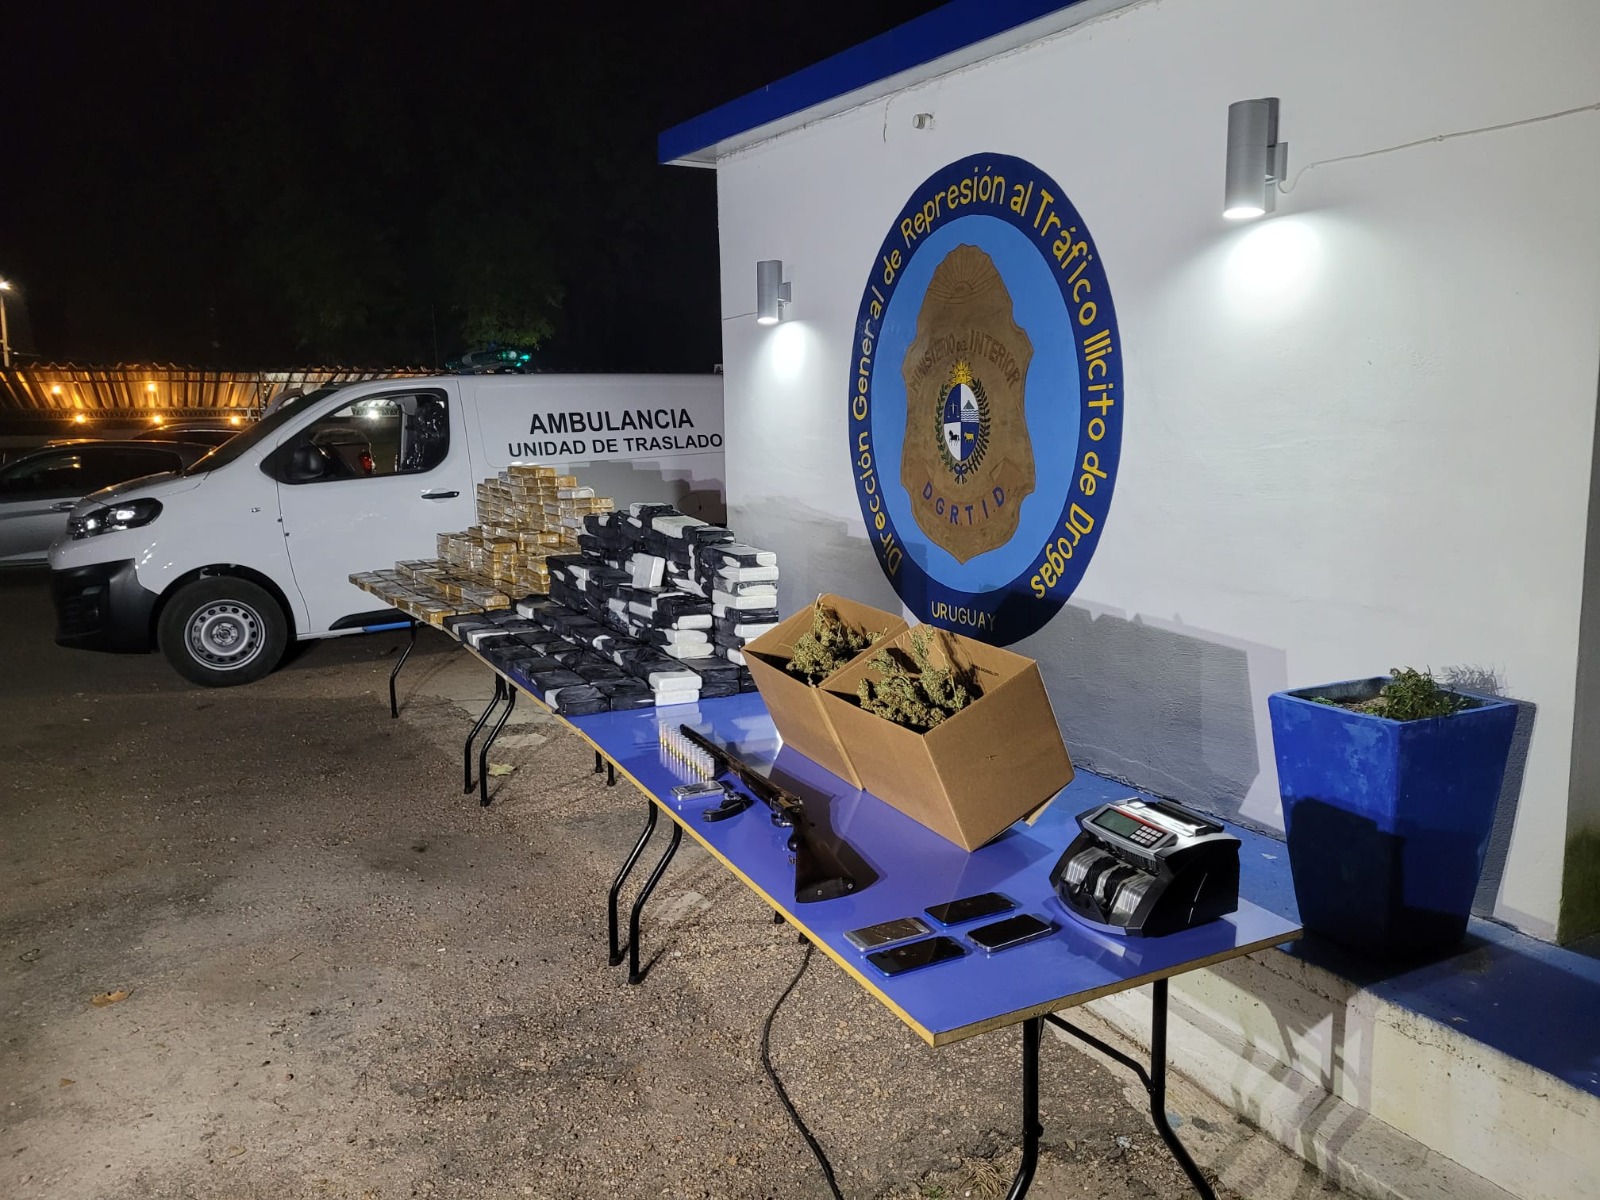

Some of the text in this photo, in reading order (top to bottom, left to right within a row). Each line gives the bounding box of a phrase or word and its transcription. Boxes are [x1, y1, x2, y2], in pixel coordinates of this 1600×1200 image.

[901, 166, 1006, 248] Represión
[1010, 181, 1033, 216] al
[884, 249, 901, 284] de
[1033, 188, 1098, 326] Tráfico
[853, 285, 885, 420] General
[968, 329, 1021, 389] INTERIOR
[508, 433, 723, 458] UNIDAD DE TRASLADO
[529, 408, 694, 435] AMBULANCIA
[1079, 451, 1108, 496] de
[857, 431, 903, 576] Dirección
[1030, 502, 1095, 599] Drogas
[930, 600, 997, 632] URUGUAY
